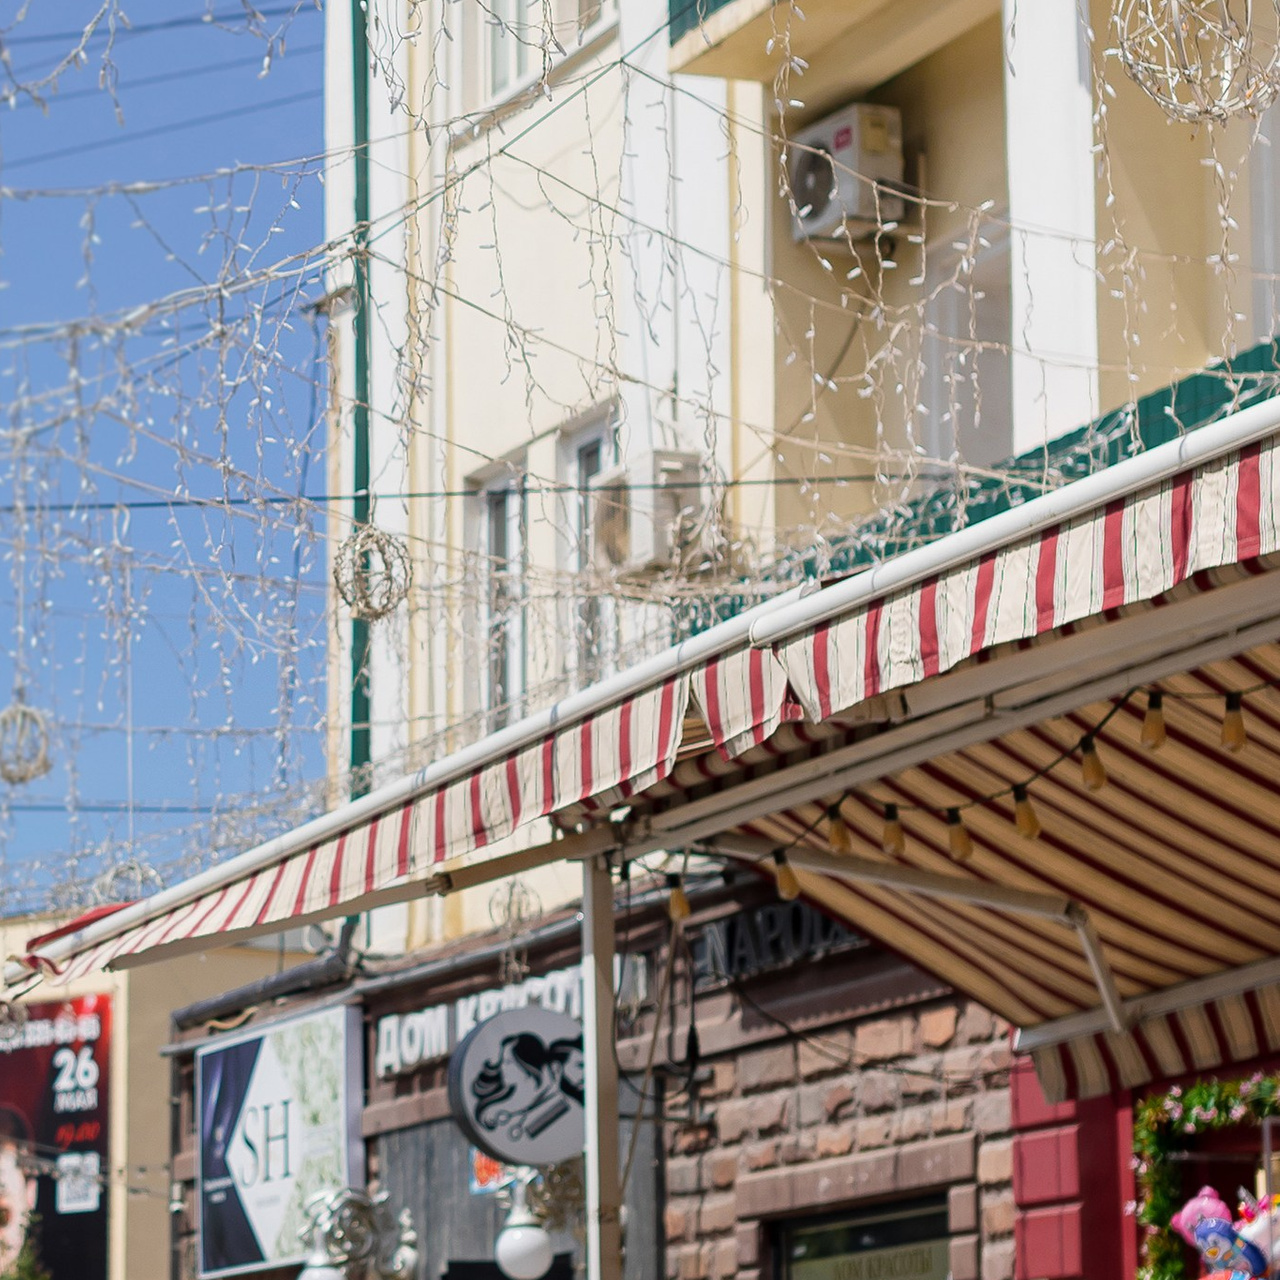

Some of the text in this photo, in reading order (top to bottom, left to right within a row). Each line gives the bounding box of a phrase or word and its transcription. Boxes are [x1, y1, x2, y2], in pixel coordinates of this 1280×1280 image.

[52, 1045, 100, 1093] 26
[375, 1003, 449, 1079] ДОМ
[240, 1098, 292, 1189] SH
